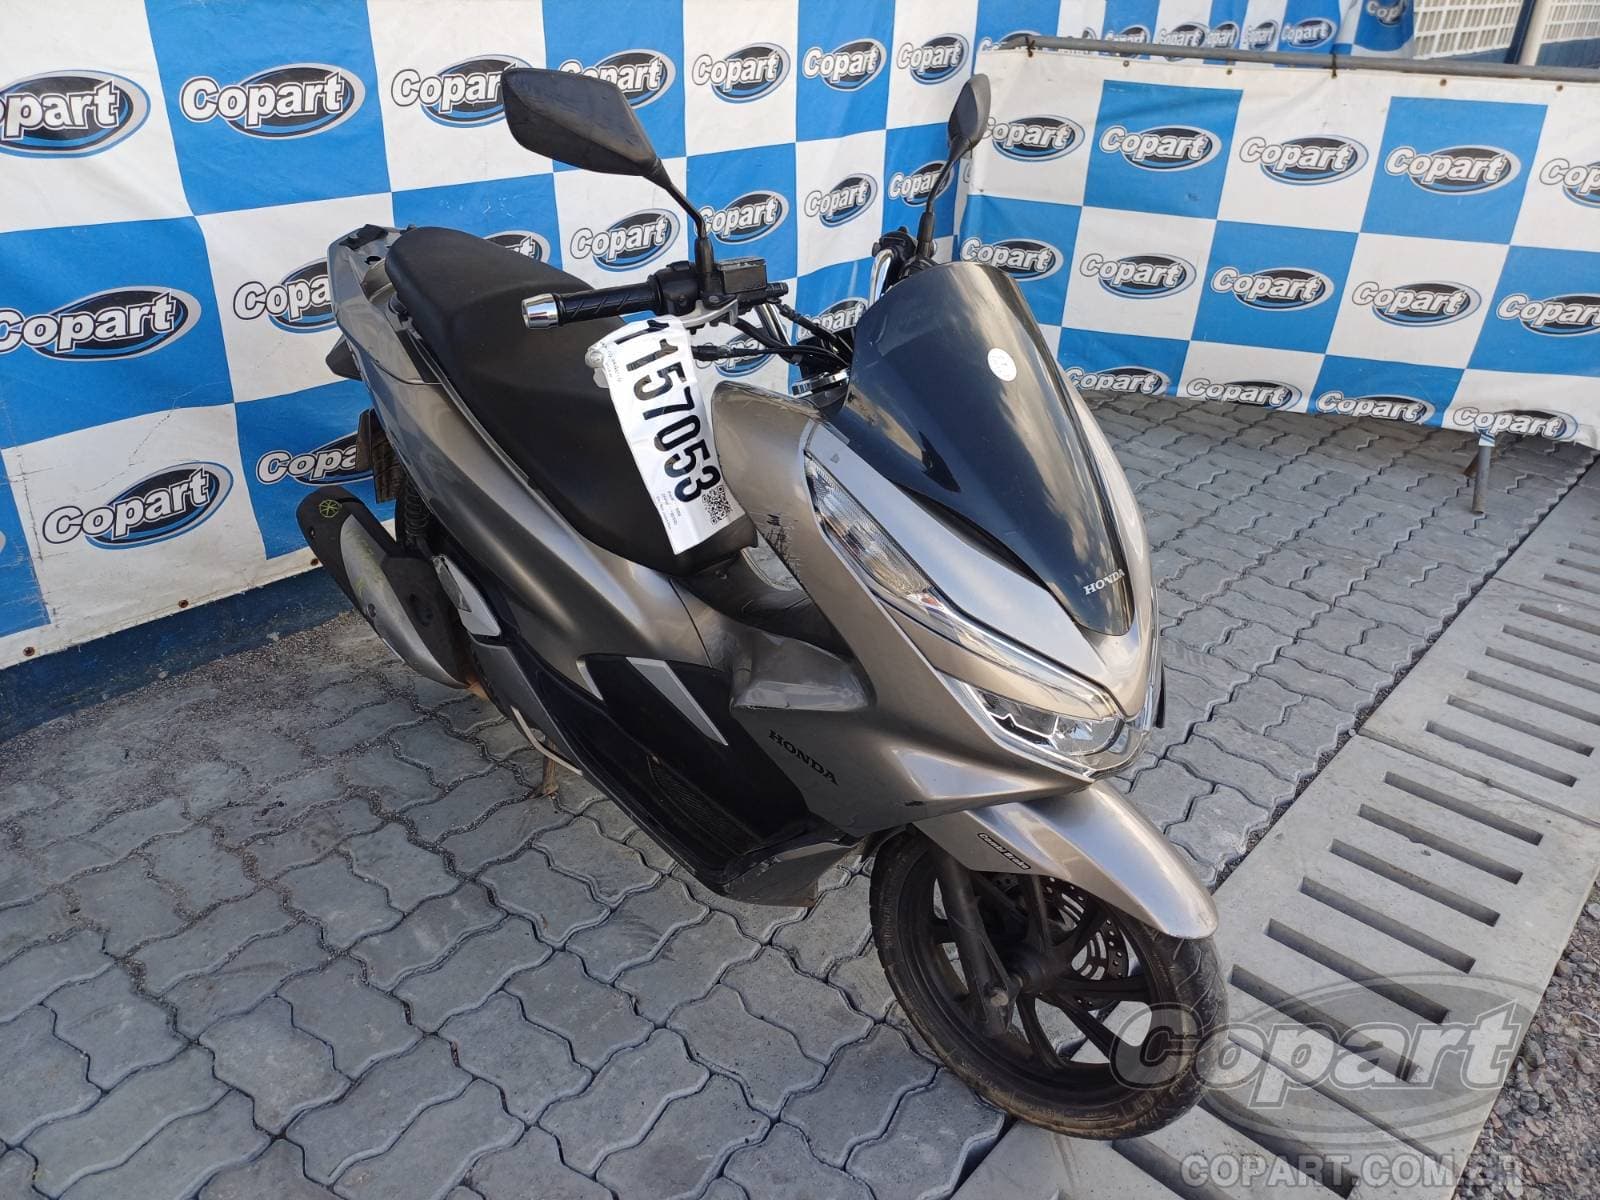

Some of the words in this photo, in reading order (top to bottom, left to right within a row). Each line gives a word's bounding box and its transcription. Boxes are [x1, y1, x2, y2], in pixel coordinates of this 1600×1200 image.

[1367, 0, 1401, 21] Cop
[1281, 23, 1329, 43] Copart
[693, 50, 780, 92] Copart
[803, 43, 882, 83] Copart
[897, 40, 962, 75] Copart
[180, 73, 345, 128] Copart
[391, 62, 517, 113] Copar
[1101, 126, 1207, 161] Copart
[1240, 137, 1353, 172] Copart
[1385, 147, 1509, 184] Copart
[1539, 158, 1600, 195] Cop
[804, 179, 869, 220] Copart
[888, 172, 942, 201] Copar
[571, 209, 668, 261] Copart
[961, 237, 1053, 272] Copart
[1080, 254, 1186, 287] Copart
[234, 275, 332, 320] Copa
[1211, 266, 1323, 301] Copart
[1352, 281, 1469, 315] Copart
[1497, 293, 1600, 328] Copar
[1187, 378, 1288, 406] Copart
[1317, 391, 1424, 422] Copart
[614, 320, 721, 503] 1157053
[1453, 406, 1563, 438] Copart
[257, 444, 356, 483] Copa
[43, 468, 209, 543] Copart
[1084, 568, 1125, 595] HONDA
[768, 729, 838, 786] HONDA
